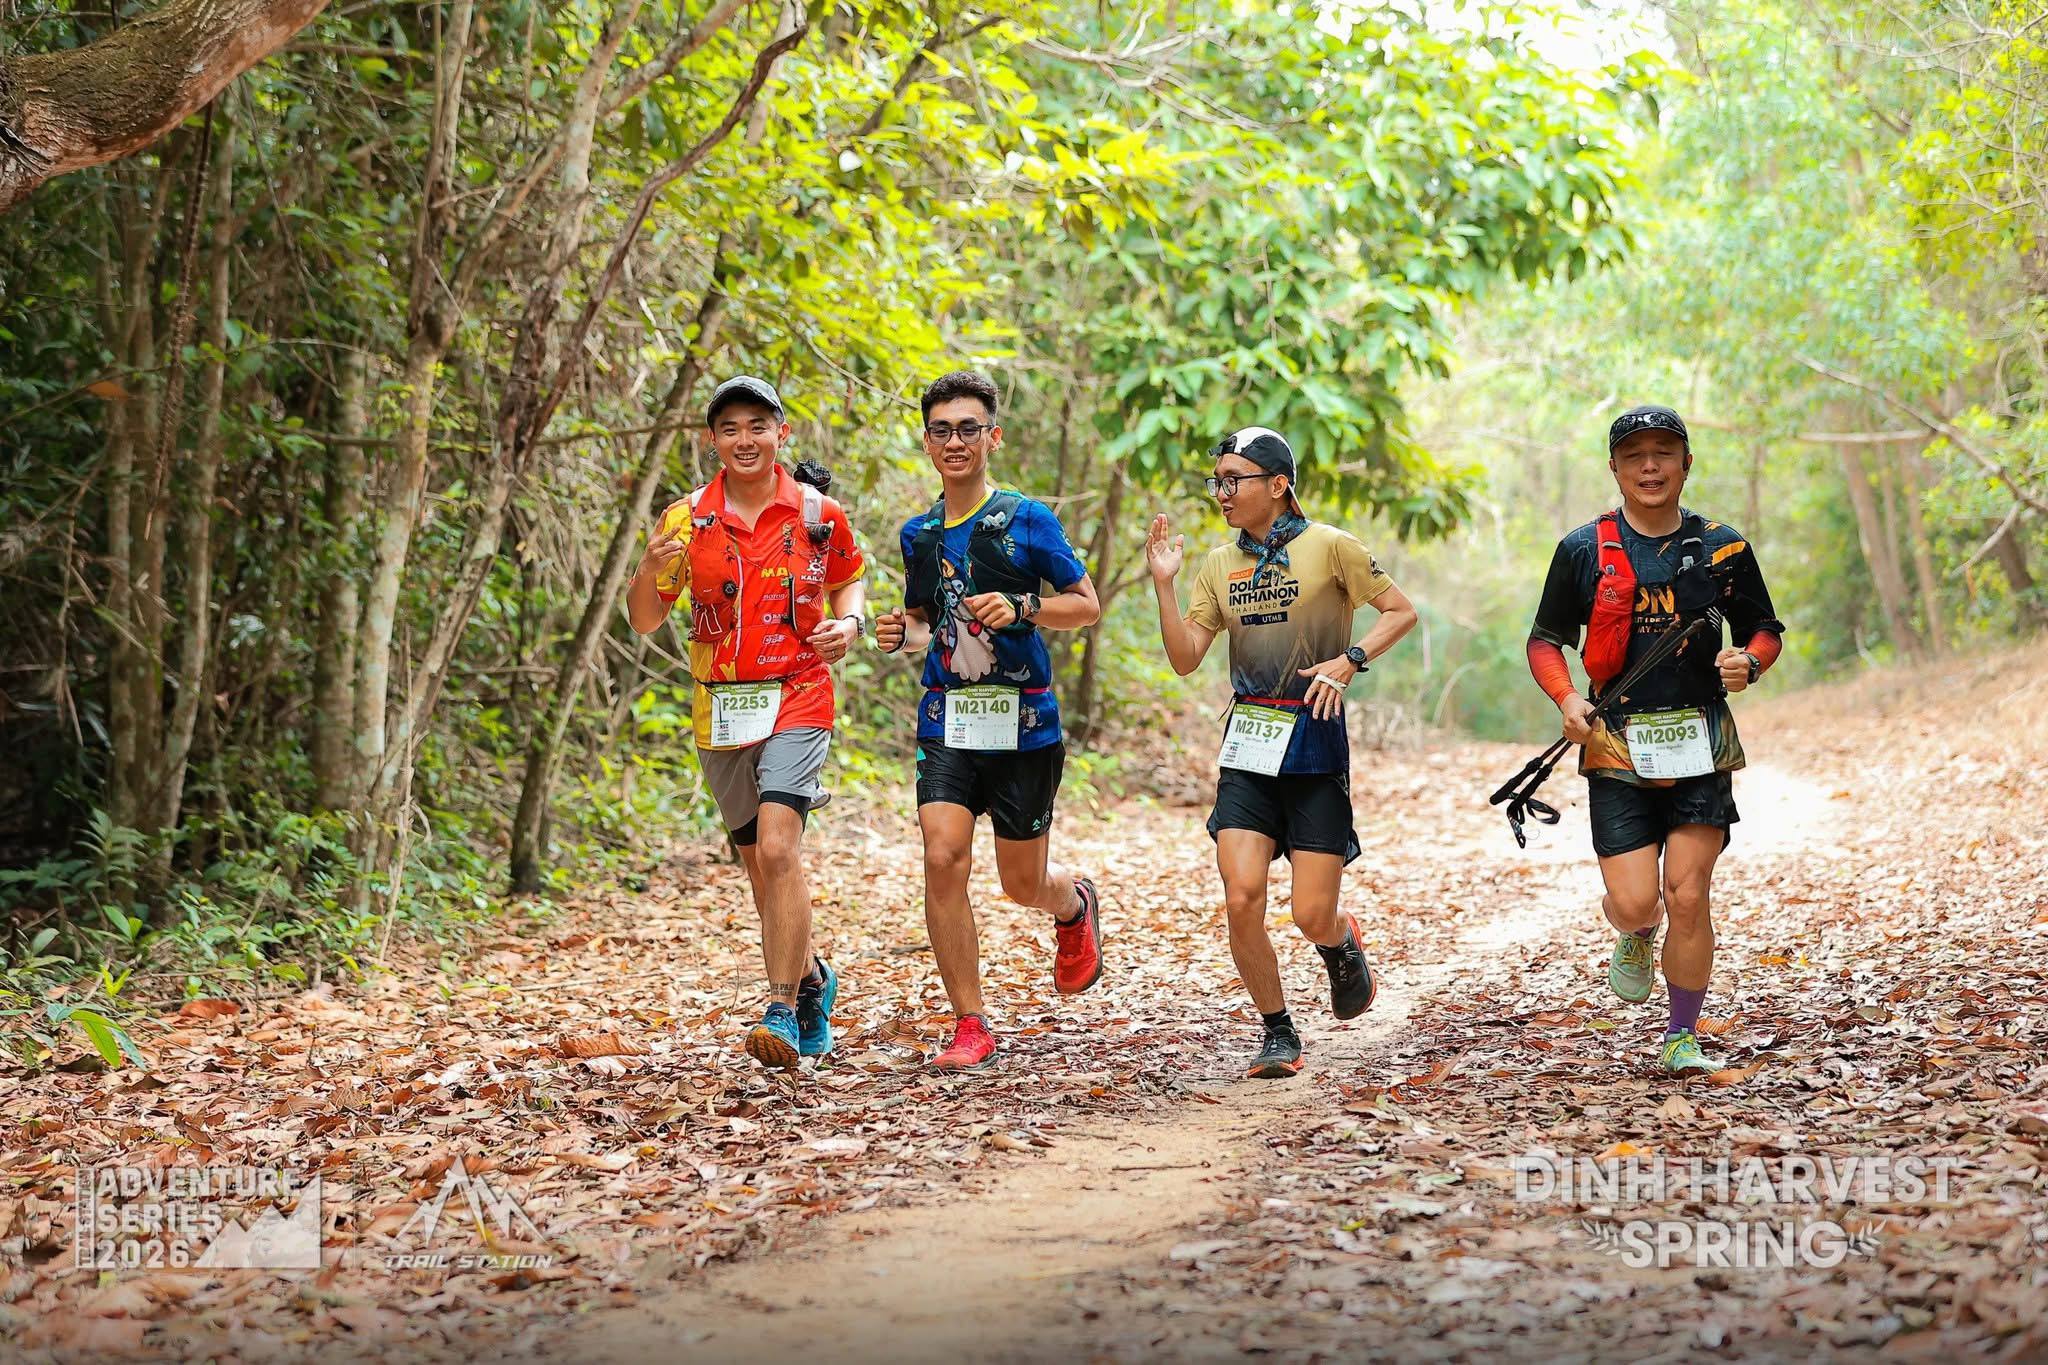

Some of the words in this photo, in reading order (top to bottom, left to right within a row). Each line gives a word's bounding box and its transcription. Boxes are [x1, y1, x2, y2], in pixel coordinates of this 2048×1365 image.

[1229, 586, 1299, 606] INTHANON
[1231, 602, 1277, 614] THAILAND
[1262, 615, 1283, 623] UTMB
[722, 696, 768, 711] F2253
[955, 700, 1010, 714] M2140
[1235, 719, 1283, 740] M2137
[1637, 725, 1698, 745] M2093
